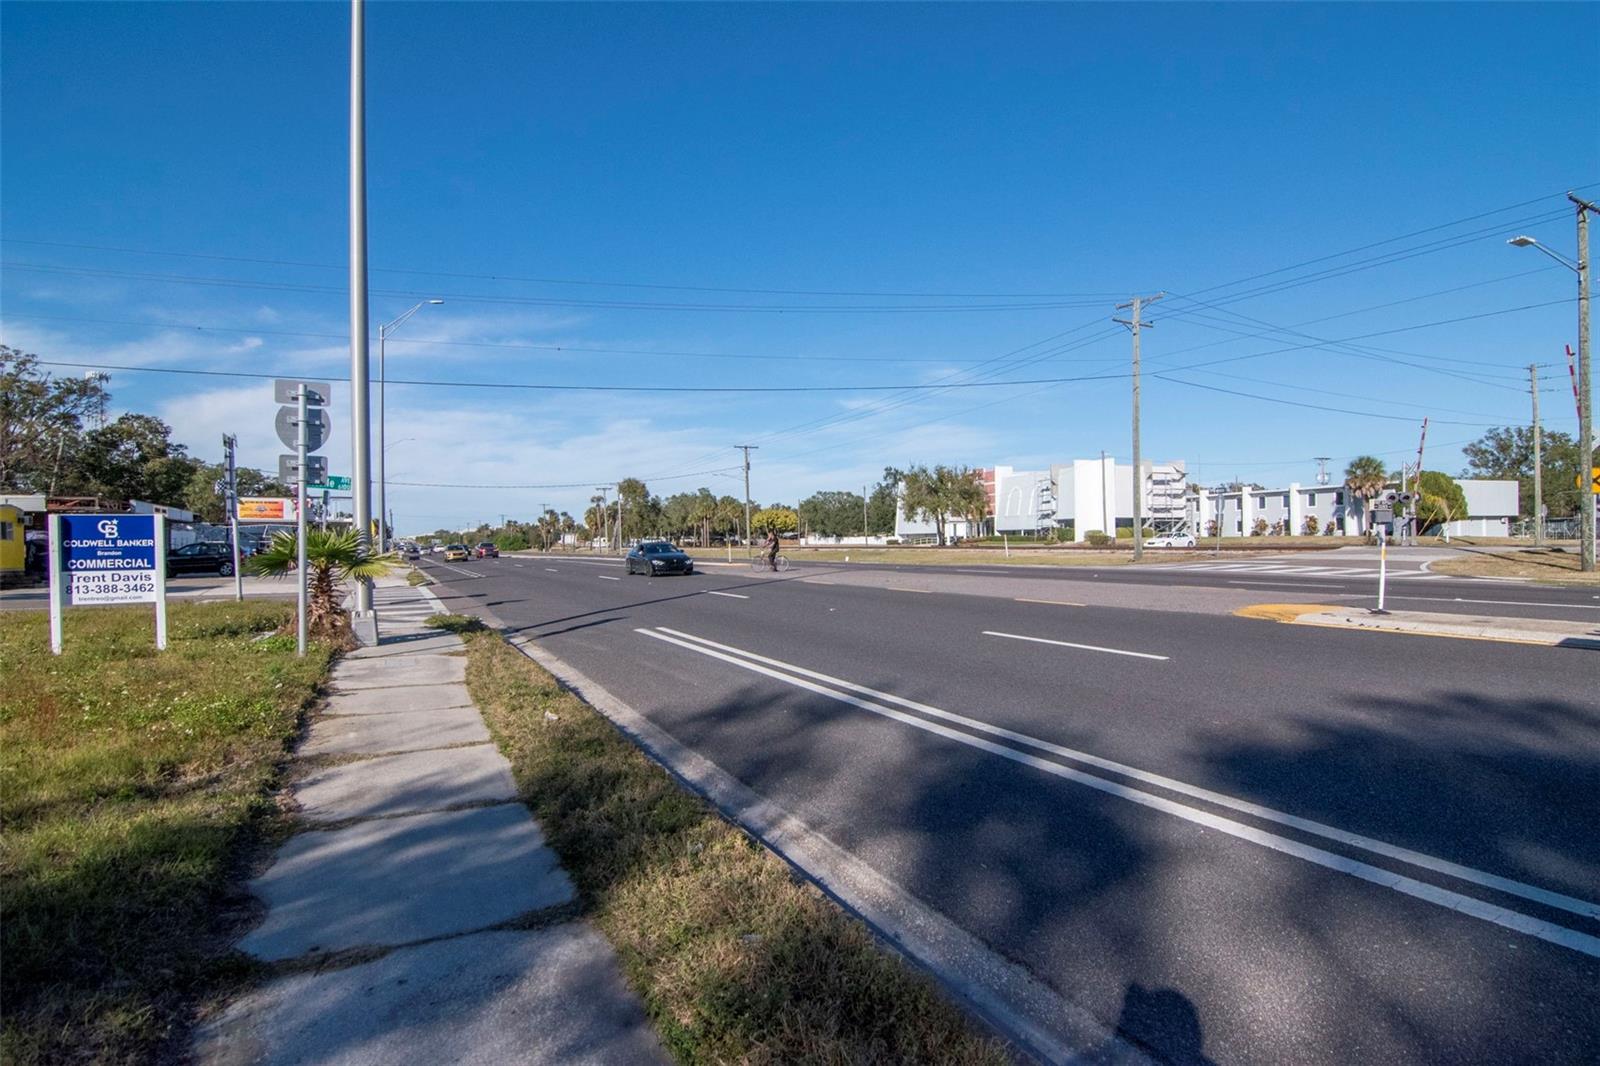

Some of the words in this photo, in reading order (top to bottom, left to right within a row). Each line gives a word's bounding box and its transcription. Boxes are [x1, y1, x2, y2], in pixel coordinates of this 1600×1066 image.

[117, 539, 154, 547] BANKER
[68, 559, 151, 569] COMMERCIAL
[69, 573, 106, 583] Trent
[111, 572, 152, 582] Davis
[65, 583, 154, 595] 813-388-3462
